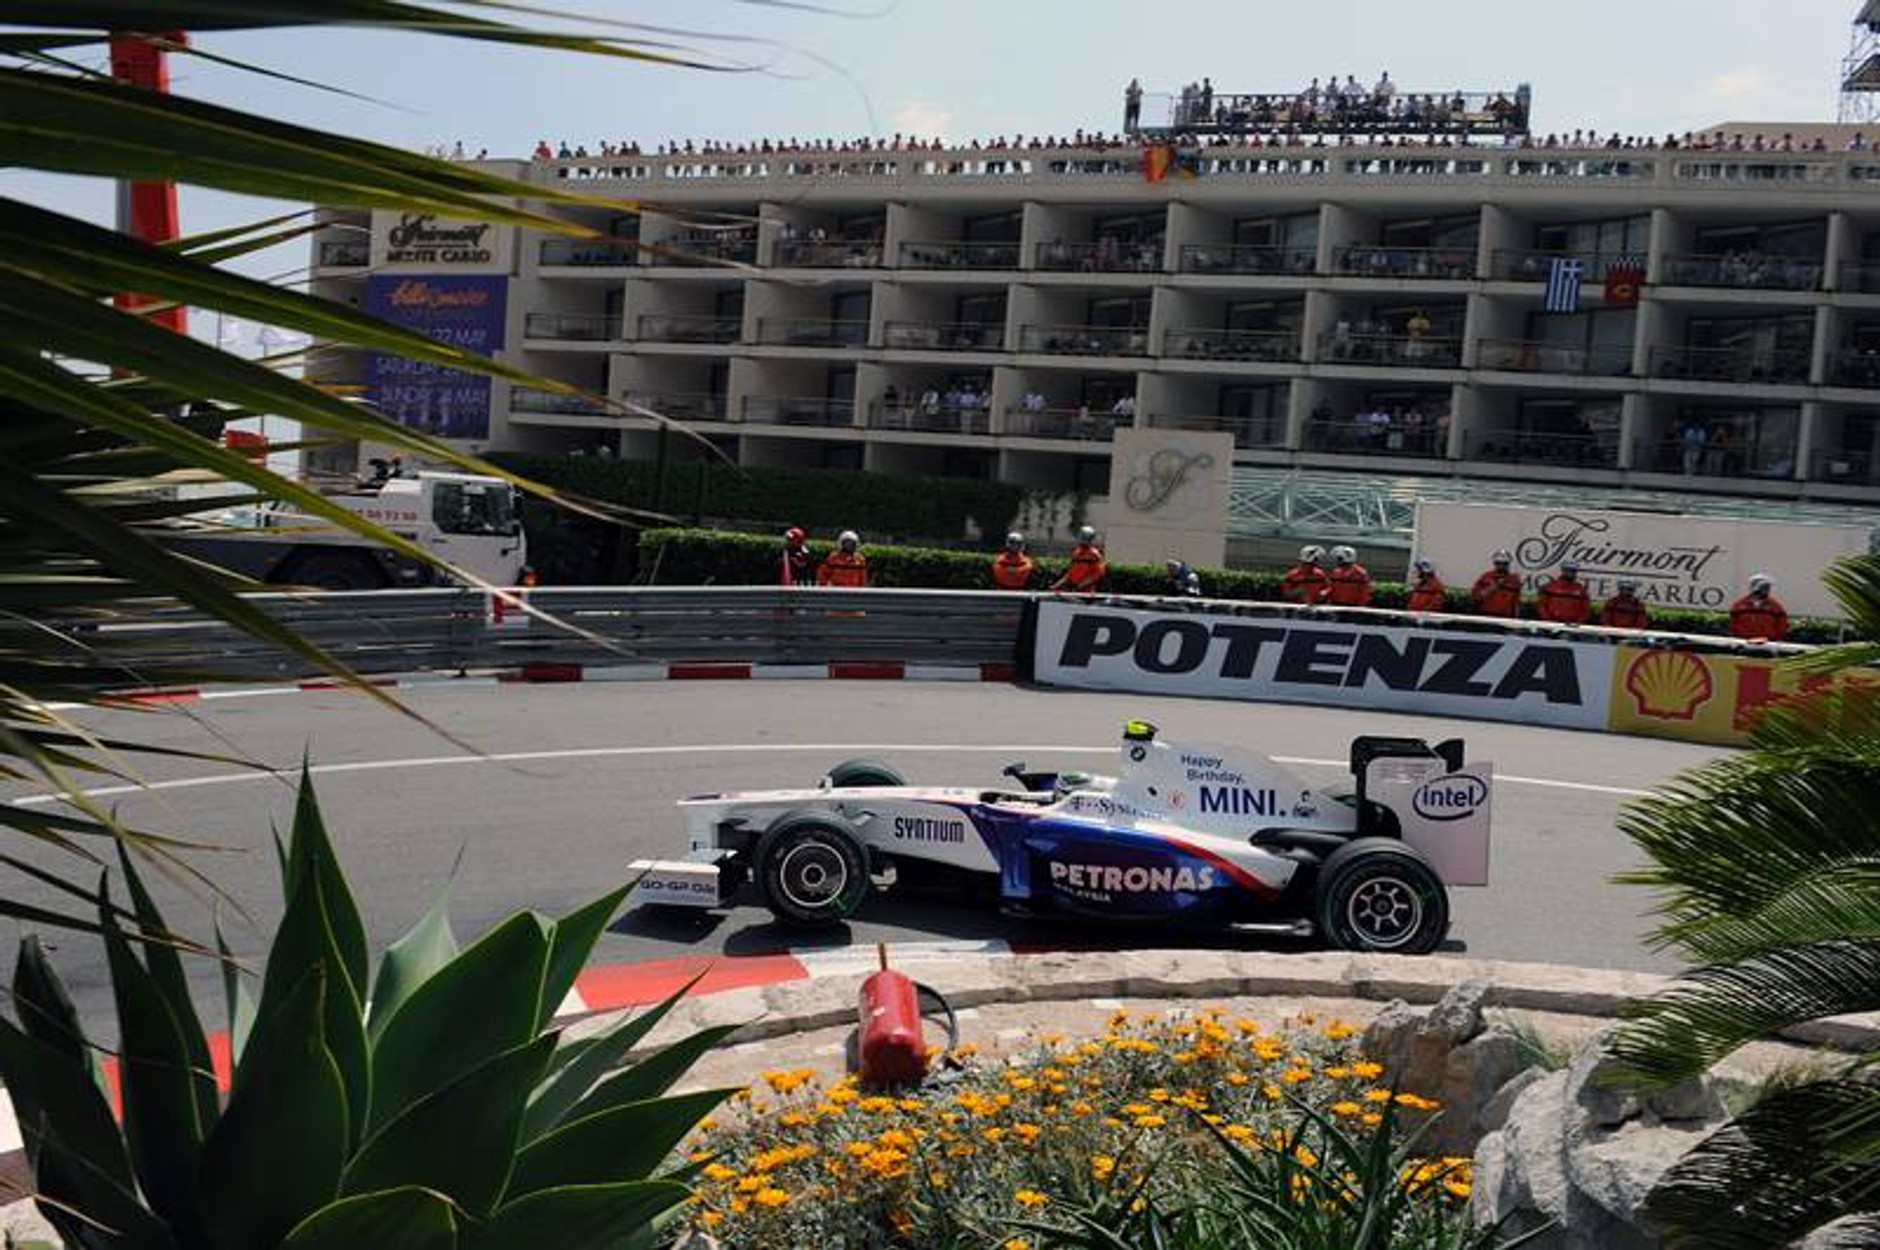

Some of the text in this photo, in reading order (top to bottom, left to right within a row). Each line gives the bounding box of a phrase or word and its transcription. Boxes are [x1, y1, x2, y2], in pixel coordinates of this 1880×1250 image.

[1516, 514, 1727, 581] Fairmont
[1634, 581, 1725, 607] ARLO
[1058, 613, 1583, 706] POTENZA
[1181, 754, 1224, 769] Happy
[1423, 784, 1475, 808] intel
[894, 817, 965, 844] SYNTIUM
[1050, 860, 1214, 892] PETRONAS
